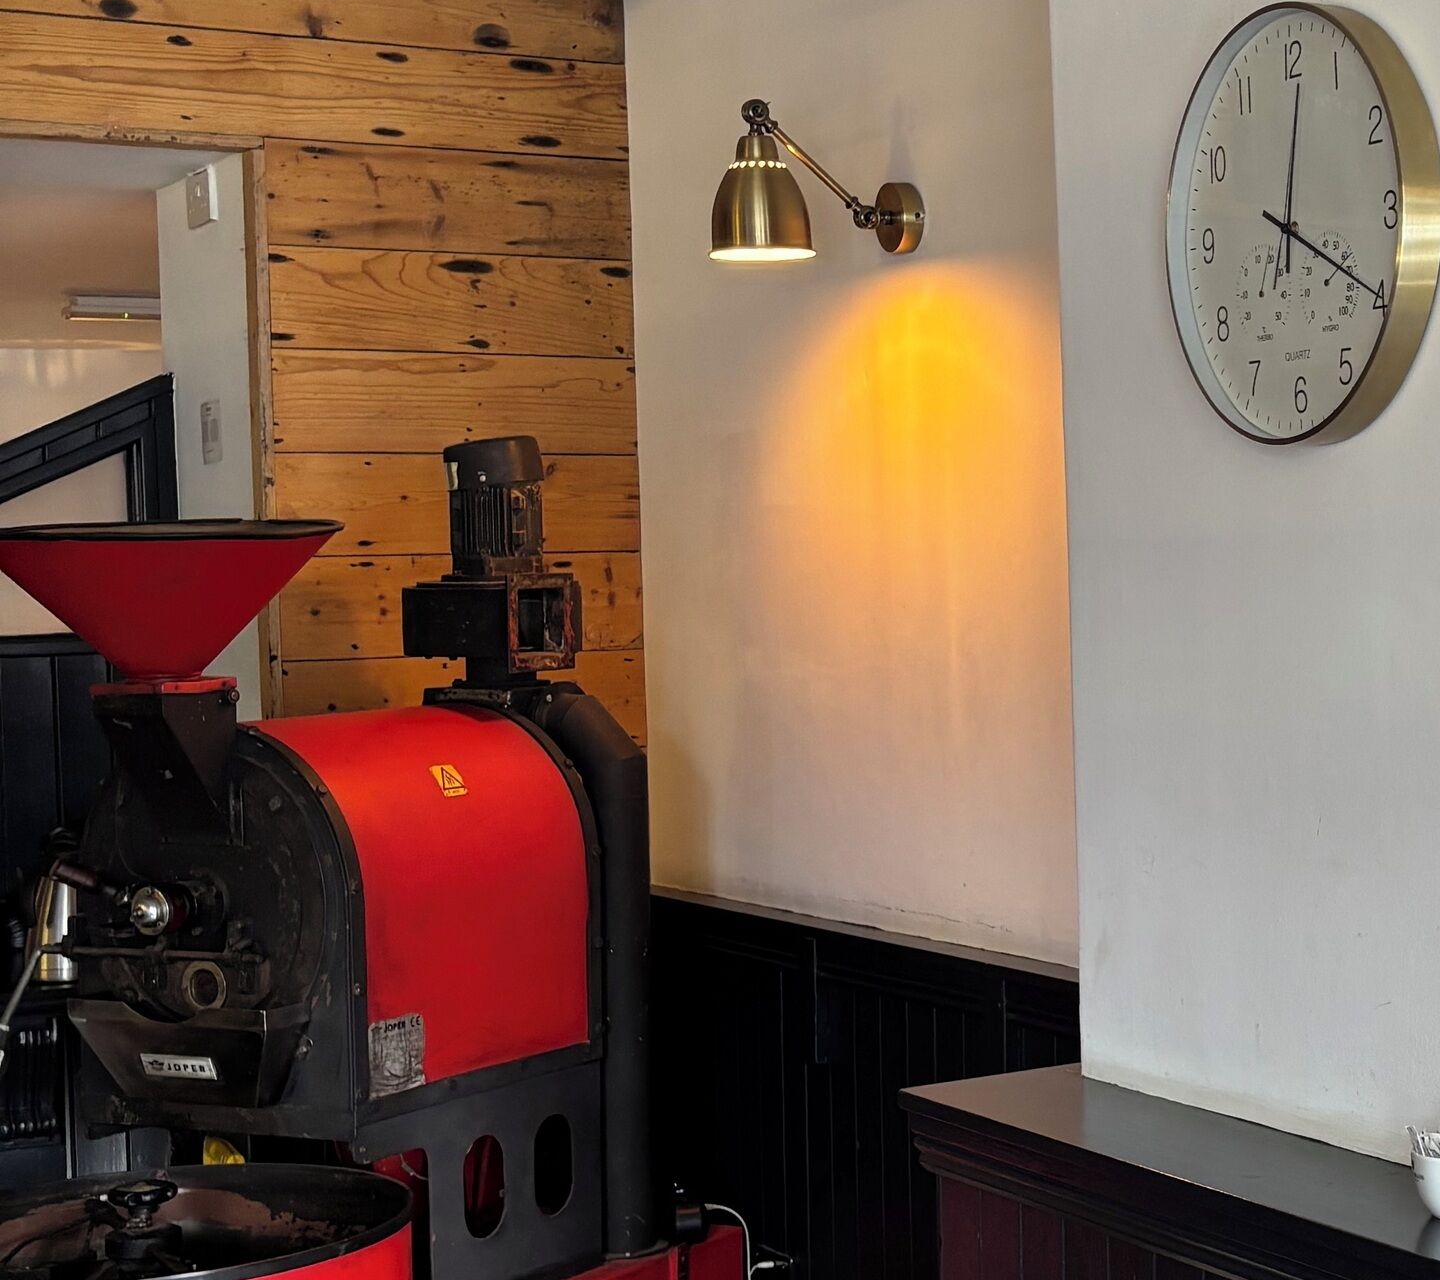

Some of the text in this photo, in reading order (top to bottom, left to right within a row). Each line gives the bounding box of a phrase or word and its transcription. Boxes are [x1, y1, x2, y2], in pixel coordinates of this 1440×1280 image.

[1284, 40, 1302, 81] 12
[1334, 51, 1338, 90] 1
[1238, 75, 1251, 115] 11
[1368, 105, 1383, 145] 2
[1210, 146, 1226, 184] 10
[1383, 190, 1398, 229] 3
[1202, 228, 1215, 264] 9
[1373, 279, 1388, 319] 4
[1216, 306, 1230, 341] 8
[1284, 349, 1311, 362] QUARTZ
[1339, 347, 1352, 385] 5
[1249, 360, 1261, 396] 7
[1294, 376, 1308, 413] 6
[168, 1063, 206, 1073] JOPER
